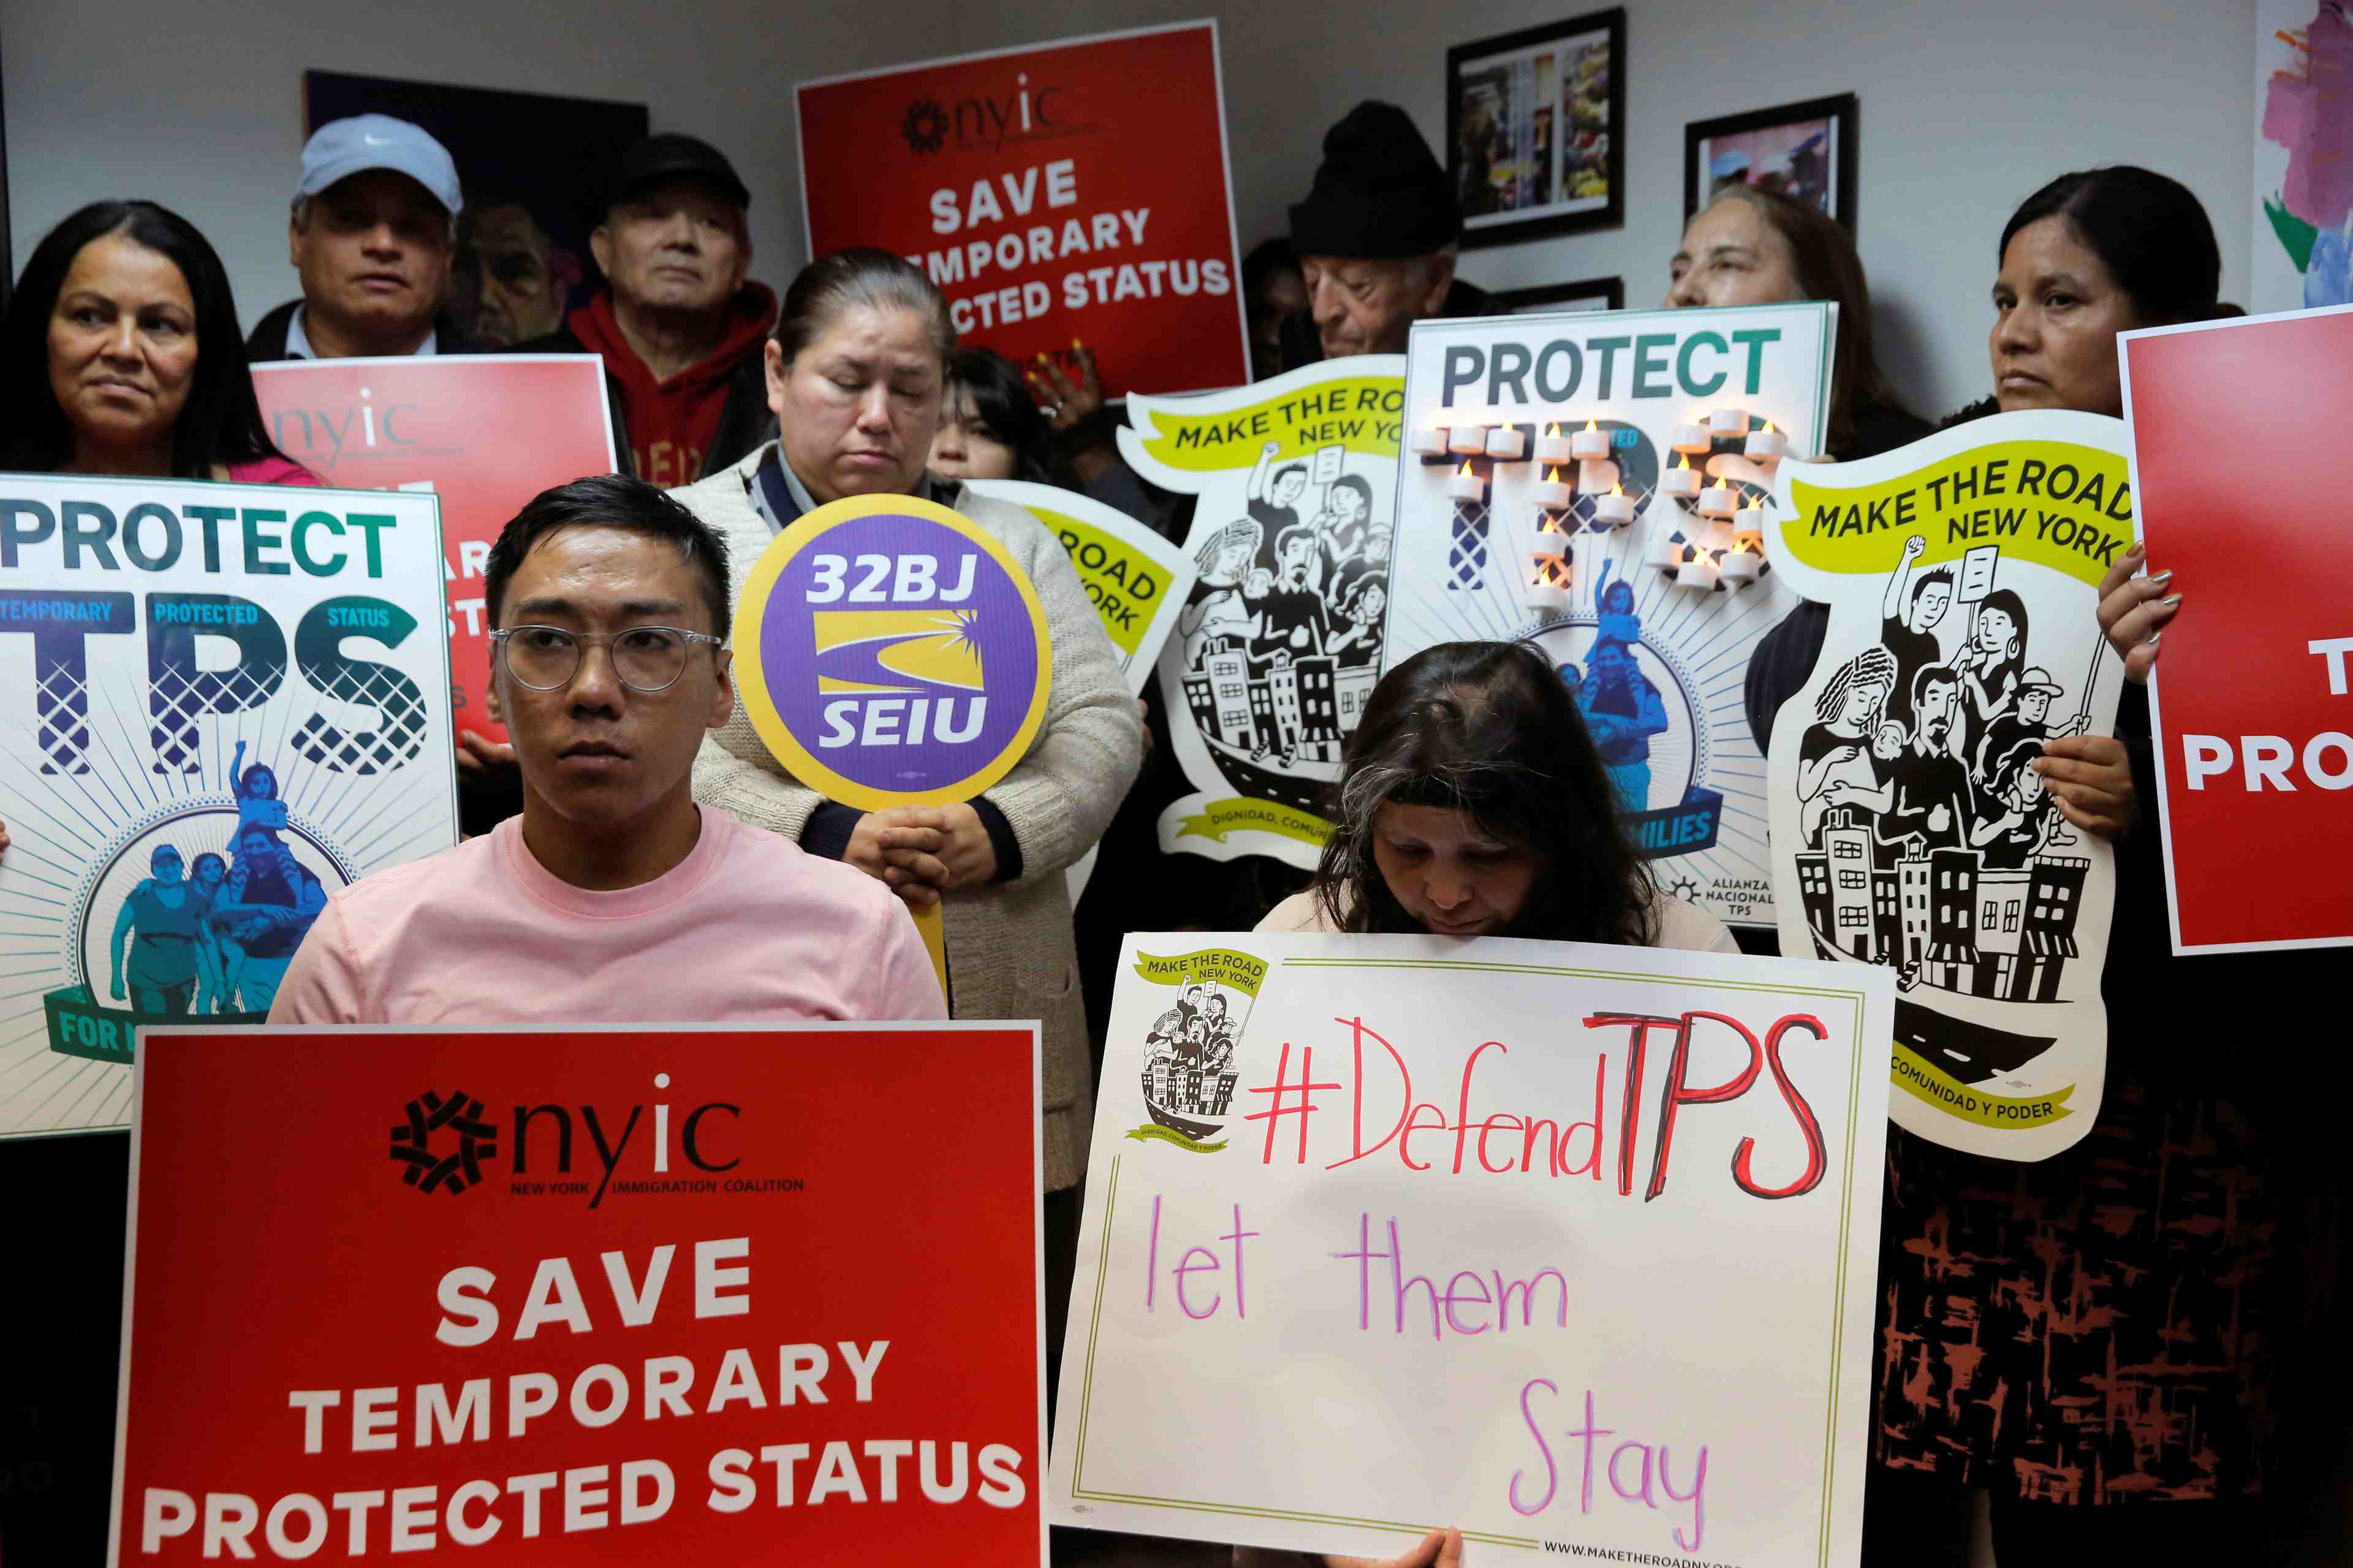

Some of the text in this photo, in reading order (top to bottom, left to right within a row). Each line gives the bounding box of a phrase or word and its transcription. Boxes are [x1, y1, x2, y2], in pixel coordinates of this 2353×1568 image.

[930, 158, 1077, 234] SAVE
[904, 208, 1150, 287] MPORARY
[950, 259, 1230, 335] CTED STATUS
[1442, 328, 1781, 407] PROTECT
[272, 387, 418, 470] nyic
[1176, 388, 1404, 449] MAKE THE RO
[1300, 420, 1401, 445] NEW YO
[1809, 460, 2132, 537] MAKE THE ROAD
[0, 499, 396, 578] PROTECT
[1947, 507, 2124, 567] NEW YORK
[806, 553, 978, 603] 32BJ
[1081, 578, 1140, 632] ORK
[0, 599, 390, 627] TEMPORARY PROTECTED STATUS
[0, 589, 427, 775] TPS
[819, 696, 987, 748] SEIU
[1211, 809, 1277, 825] DIGNIDAD,
[1706, 891, 1775, 904] NACIONAL
[1712, 878, 1769, 891] ALIANZA
[1728, 904, 1751, 915] TPS
[1147, 954, 1262, 977] MAKE THE ROAD
[1199, 969, 1257, 990] NEW YORK
[59, 1010, 119, 1050] FOR
[1890, 1056, 2053, 1119] COMUNIDAD Y PODER
[513, 1073, 740, 1208] nyic
[510, 1179, 804, 1195] NEW YORK IMMIGRATION COALITION
[435, 1237, 749, 1347] SAVE
[1147, 1194, 1567, 1341] let them
[289, 1340, 890, 1454] TEMPORARY
[1509, 1378, 1708, 1551] Stay
[142, 1439, 1026, 1560] PROTECTED STATUS
